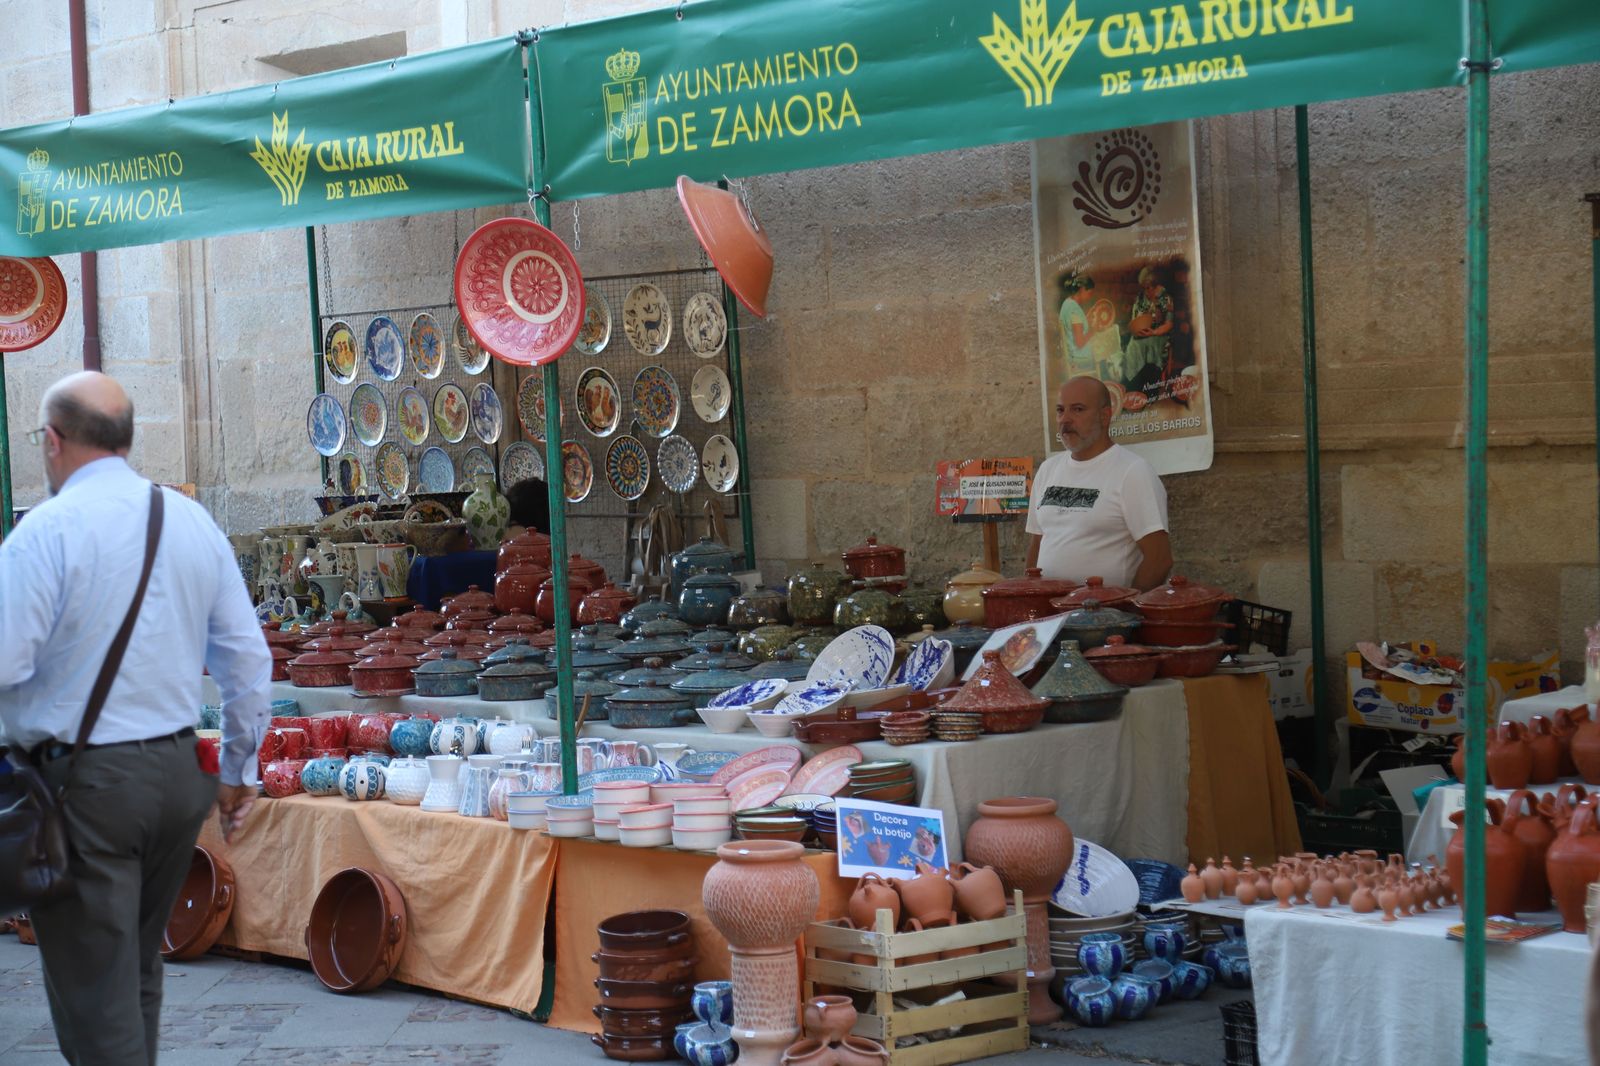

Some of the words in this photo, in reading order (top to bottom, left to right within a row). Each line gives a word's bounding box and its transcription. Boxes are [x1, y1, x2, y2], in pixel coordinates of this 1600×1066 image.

[1098, 4, 1198, 58] CAJA
[1199, 0, 1354, 44] RURAL
[655, 42, 860, 105] AYUNTAMIENTO
[1100, 70, 1132, 97] DE
[1142, 54, 1248, 91] ZAMORA
[656, 111, 698, 156] DE
[710, 87, 863, 149] ZAMORA
[315, 134, 376, 173] CAJA
[376, 121, 465, 164] RURAL
[52, 151, 184, 192] AYUNTAMIENTO
[325, 182, 345, 201] DE
[349, 173, 410, 198] ZAMORA
[50, 199, 77, 231] DE
[84, 184, 183, 226] ZAMORA
[1126, 425, 1141, 435] DE
[1141, 422, 1161, 433] LOS
[1162, 416, 1202, 432] BARROS
[1397, 702, 1434, 716] Coplaca
[872, 826, 882, 835] tu
[884, 826, 912, 840] botijo
[873, 812, 908, 825] Decora
